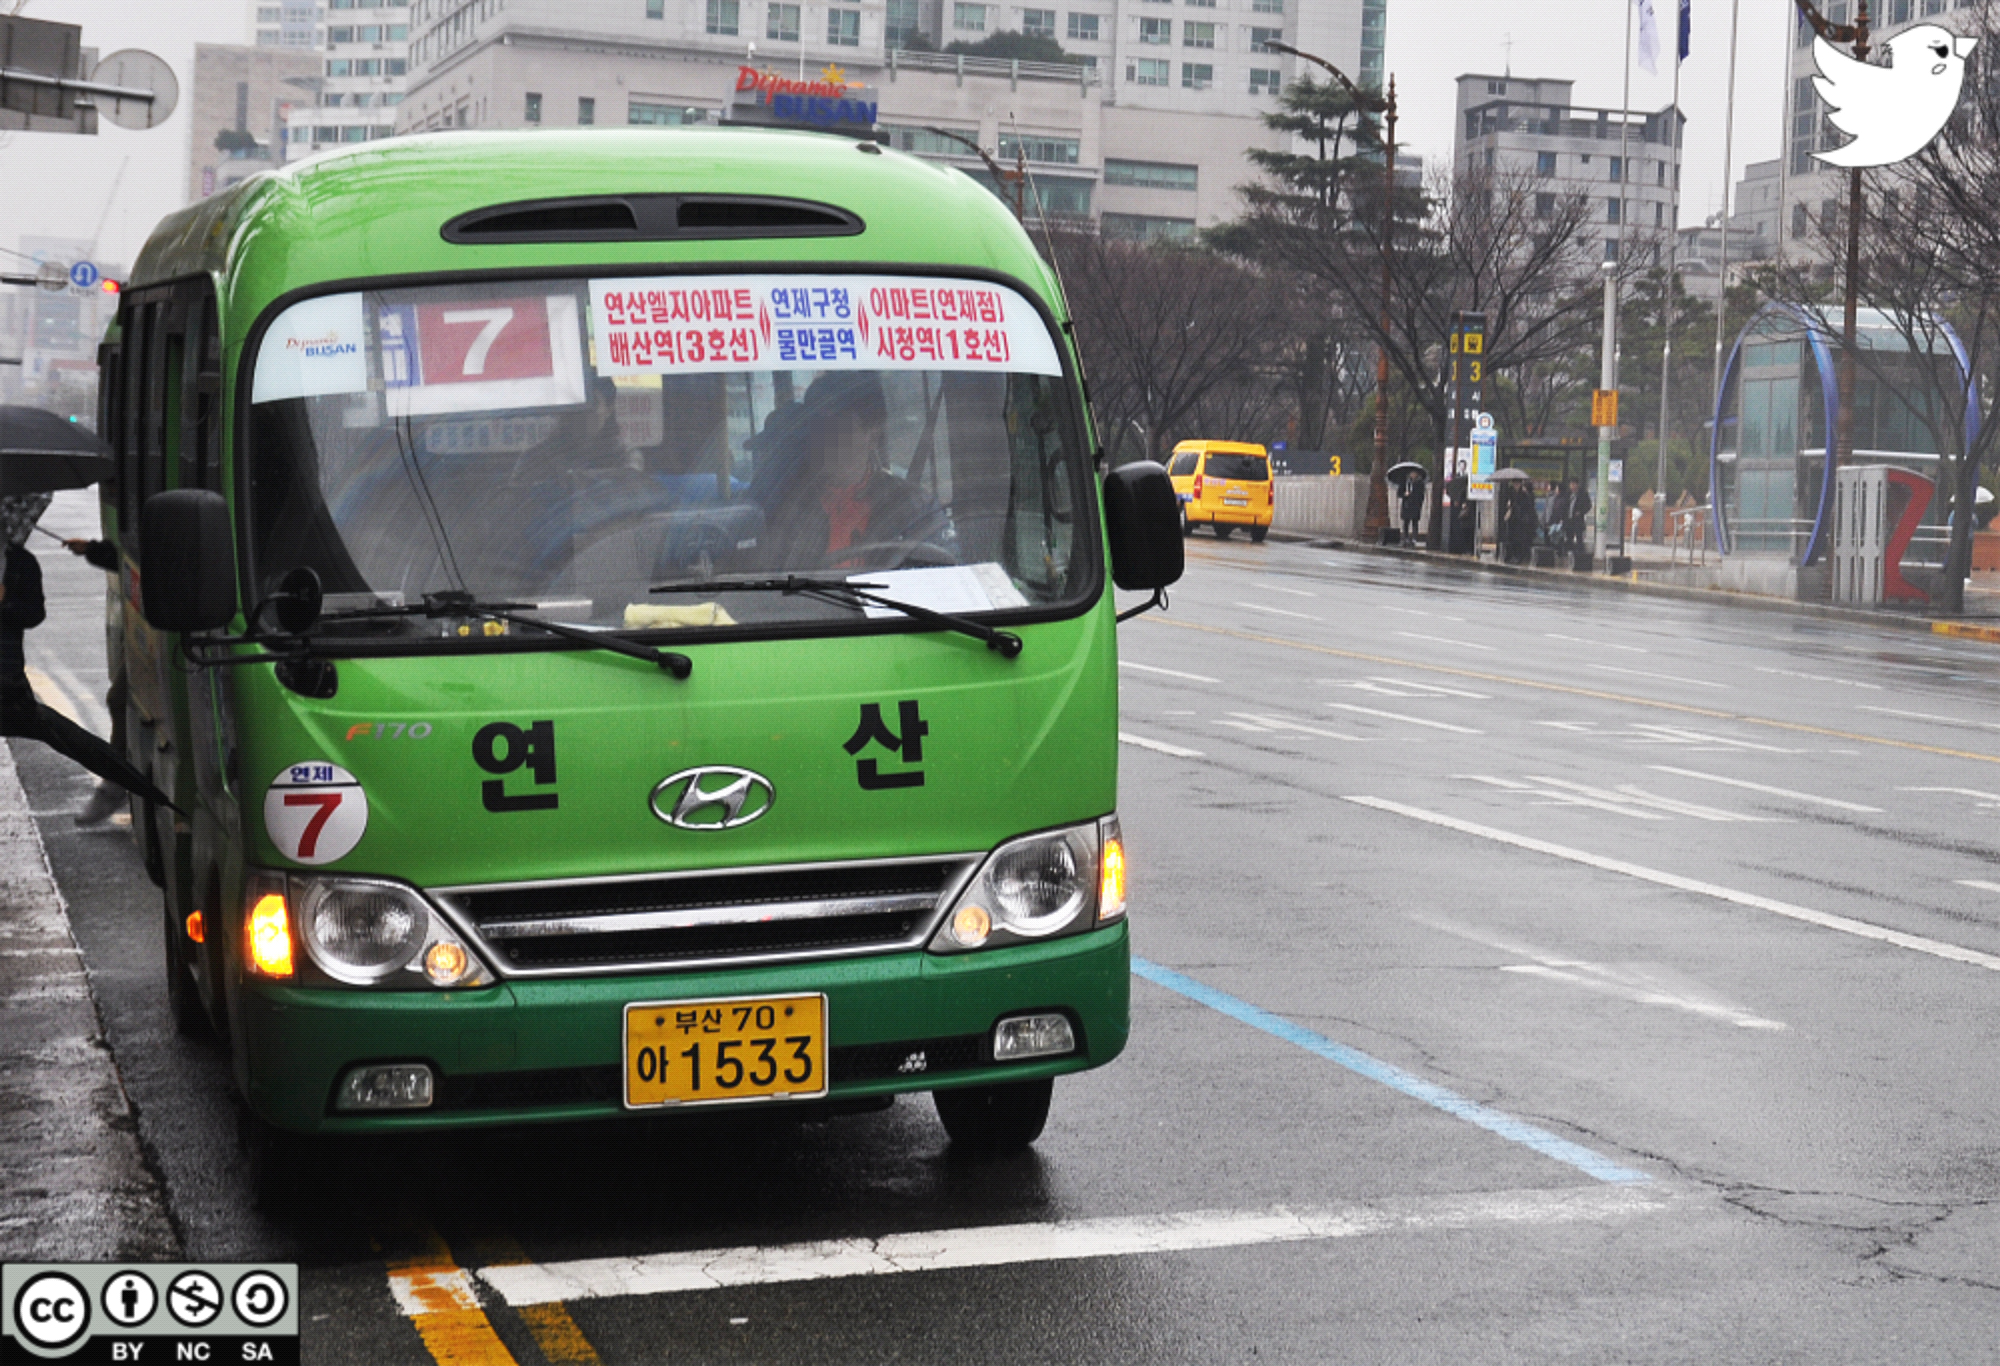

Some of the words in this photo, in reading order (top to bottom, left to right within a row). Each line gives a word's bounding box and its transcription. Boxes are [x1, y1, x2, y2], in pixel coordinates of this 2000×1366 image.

[735, 65, 848, 105] Dynamic
[773, 94, 878, 127] BUSAN
[604, 288, 755, 325] 연산엘지아파트
[771, 287, 851, 319] 연제구청
[305, 343, 357, 358] BUSAN
[442, 307, 514, 376] 7
[608, 328, 759, 367] 배산역(3호선)
[777, 328, 857, 361] 물만골역
[877, 326, 1010, 363] 시청역(1호선)
[1469, 360, 1482, 383] 3
[1329, 455, 1342, 477] 3
[345, 721, 433, 741] F170
[472, 719, 559, 813] 연
[842, 699, 929, 791] 산
[283, 793, 343, 858] 7
